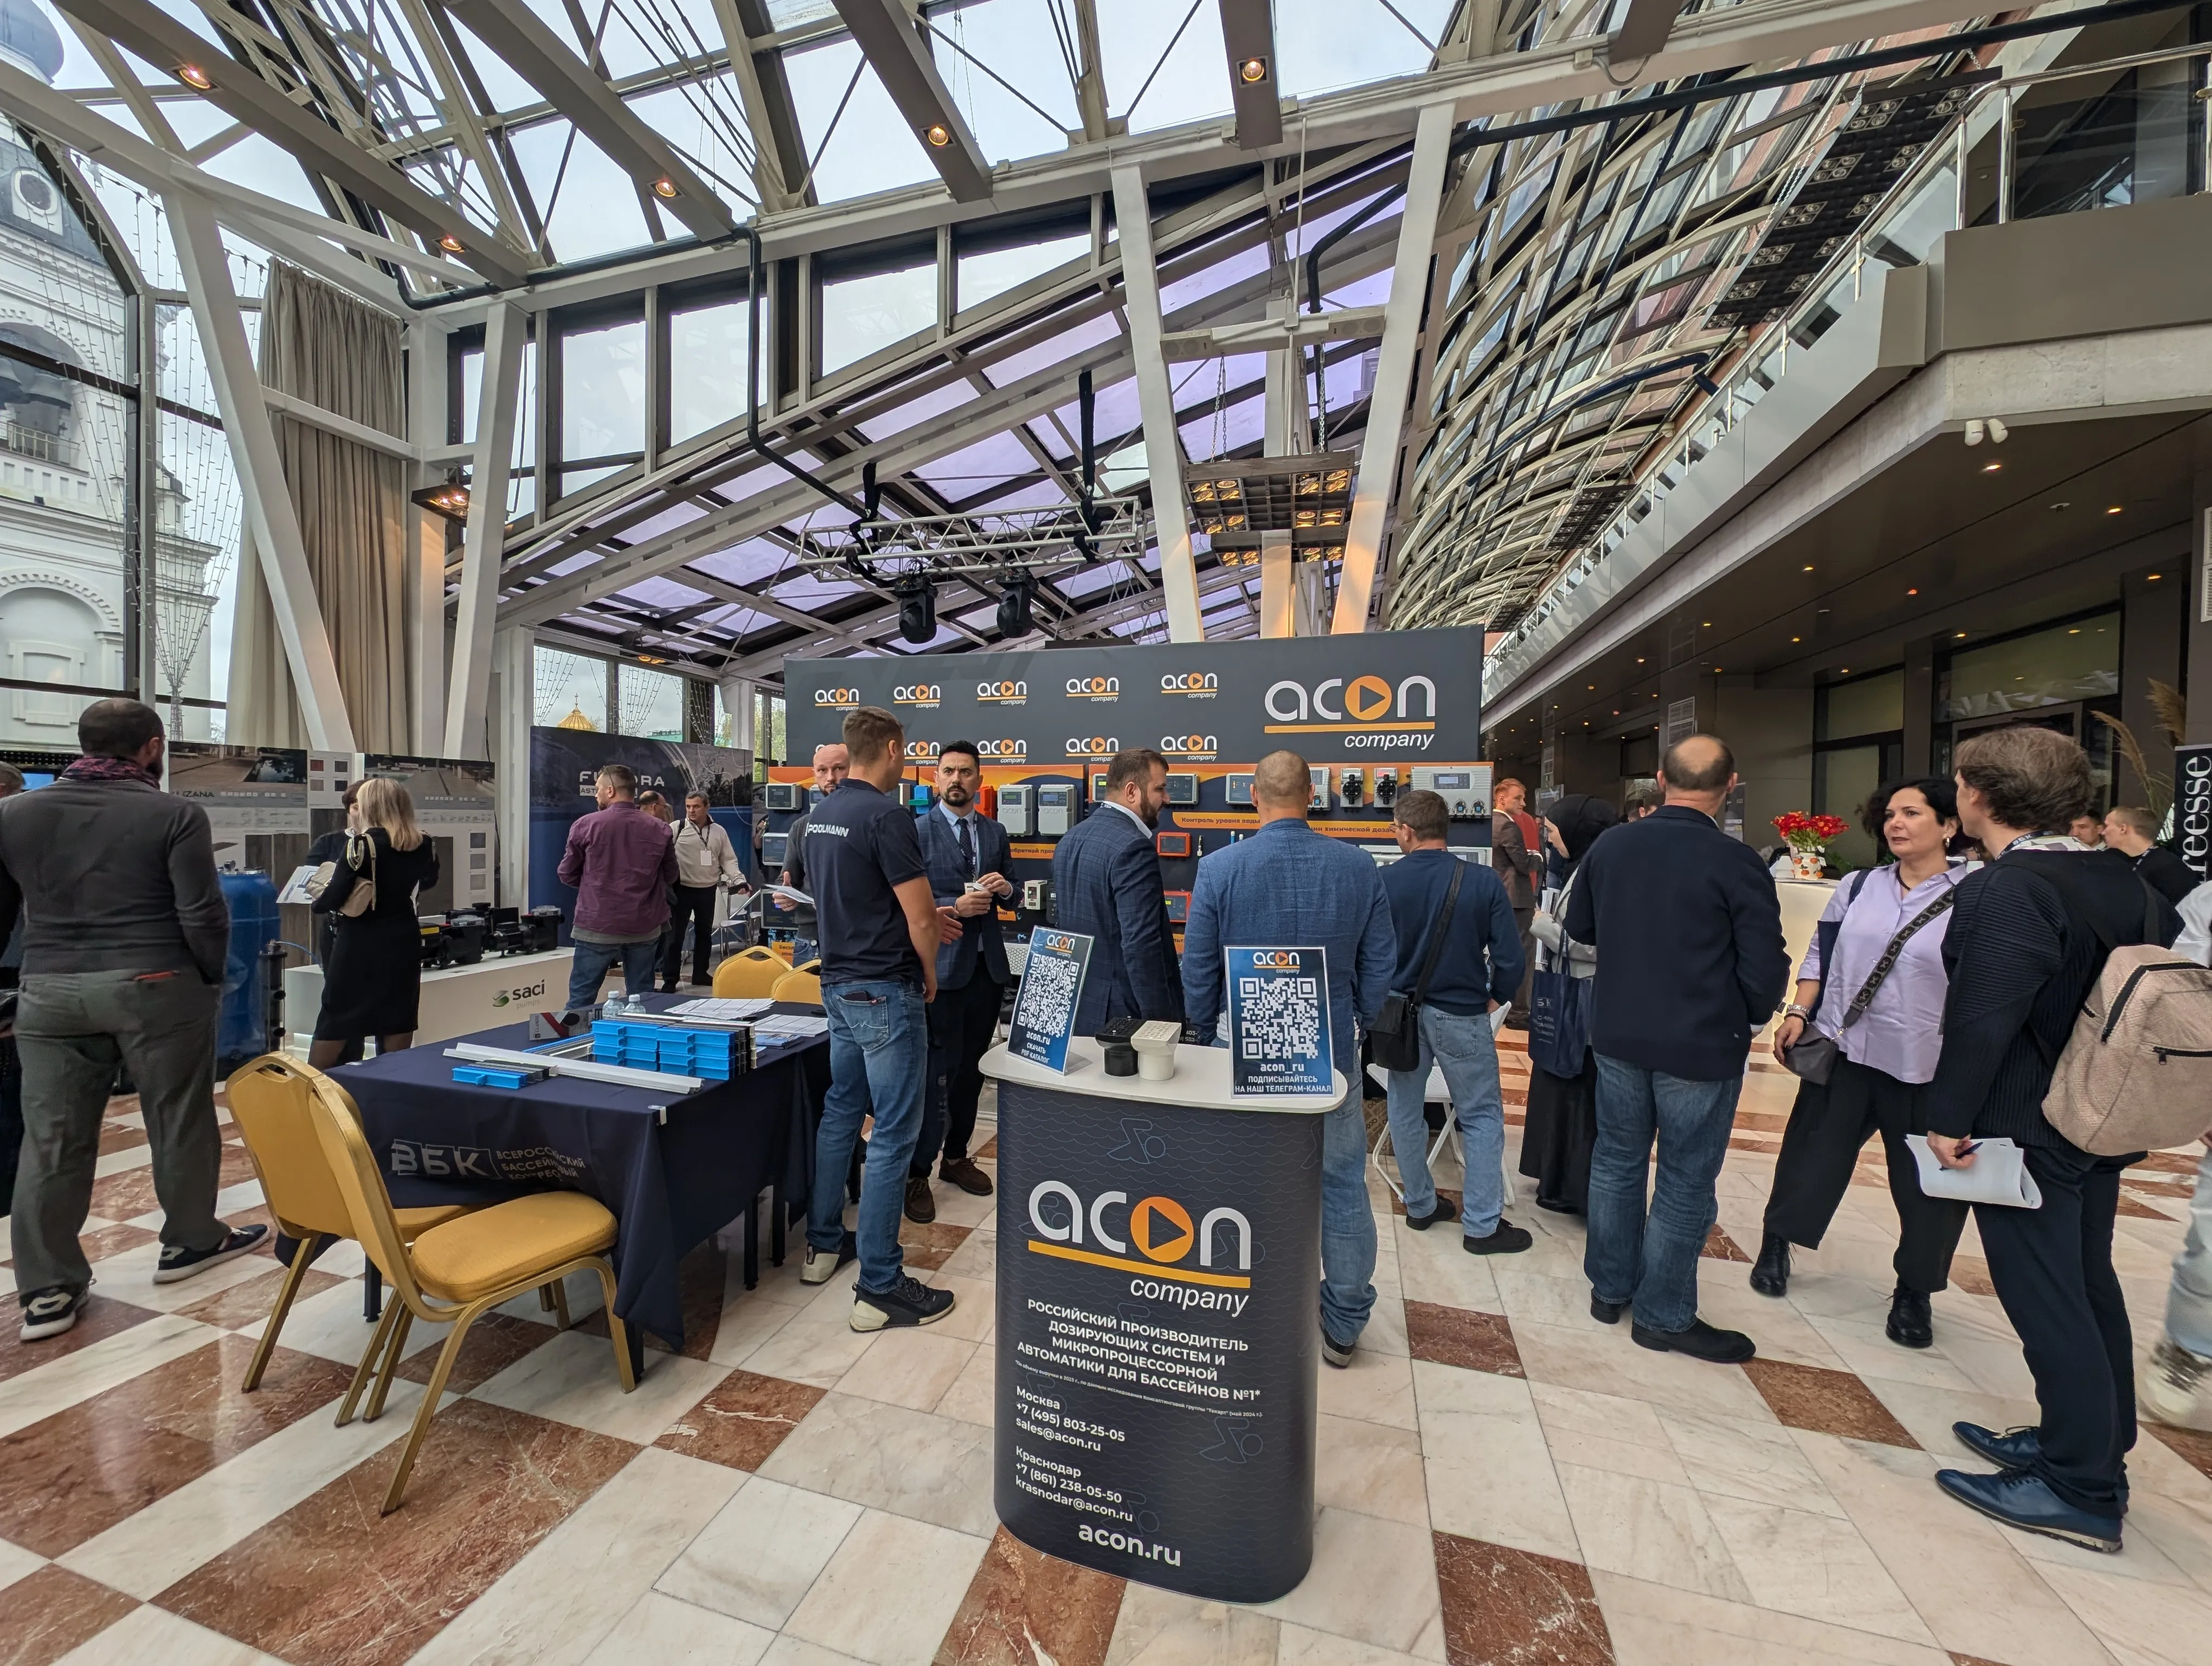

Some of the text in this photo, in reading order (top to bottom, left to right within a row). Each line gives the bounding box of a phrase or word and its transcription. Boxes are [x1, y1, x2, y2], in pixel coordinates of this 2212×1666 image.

[977, 681, 1027, 696] acon
[1066, 677, 1119, 693] acon
[1161, 672, 1217, 690] acon
[814, 688, 859, 703] acon
[893, 684, 941, 700] acon
[1265, 675, 1436, 721] acon
[904, 741, 940, 756] con
[977, 739, 1027, 755] acon
[1066, 737, 1119, 753] acon
[1161, 734, 1217, 752] acon
[1344, 733, 1435, 751] company
[807, 824, 849, 837] POOLMANN
[1046, 934, 1076, 951] acon
[1253, 952, 1300, 965] acon
[512, 979, 545, 1000] saci
[517, 999, 541, 1009] pumps
[1026, 1030, 1050, 1045] acon.ru
[1027, 1041, 1046, 1054] СКАЧАТЬ
[1030, 1052, 1050, 1064] КАТАЛОГ
[1260, 1062, 1304, 1073] acon_ru
[1248, 1074, 1318, 1084] ПОДПИСЫВАЙТЕСЬ
[391, 1142, 491, 1177] ВБК
[1029, 1181, 1251, 1270] acon
[1130, 1279, 1249, 1317] company
[1028, 1299, 1249, 1351] РОССИЙСКИЙ ПРОИЗВОДИТЕЛЬ
[1049, 1321, 1225, 1366] ДОЗИРУЮЩИХ СИСТЕМ И
[1052, 1337, 1218, 1381] МИКРОПРОЦЕССОРНОЙ
[1018, 1342, 1104, 1374] АВТОМАТИКИ
[1108, 1366, 1136, 1382] ДЛЯ
[1141, 1373, 1229, 1399] БАССЕЙНОВ
[1039, 1369, 1059, 1379] выручки
[1017, 1386, 1060, 1410] Москва
[1016, 1402, 1126, 1442] +7 (495) 803-25-05
[1016, 1417, 1101, 1452] sales@acon.ru
[1016, 1446, 1082, 1477] Краснодар
[1016, 1462, 1122, 1503] +7 (861) 238-05-50
[1016, 1476, 1133, 1522] krasnodar@acon.ru
[1078, 1524, 1181, 1567] acon.ru
